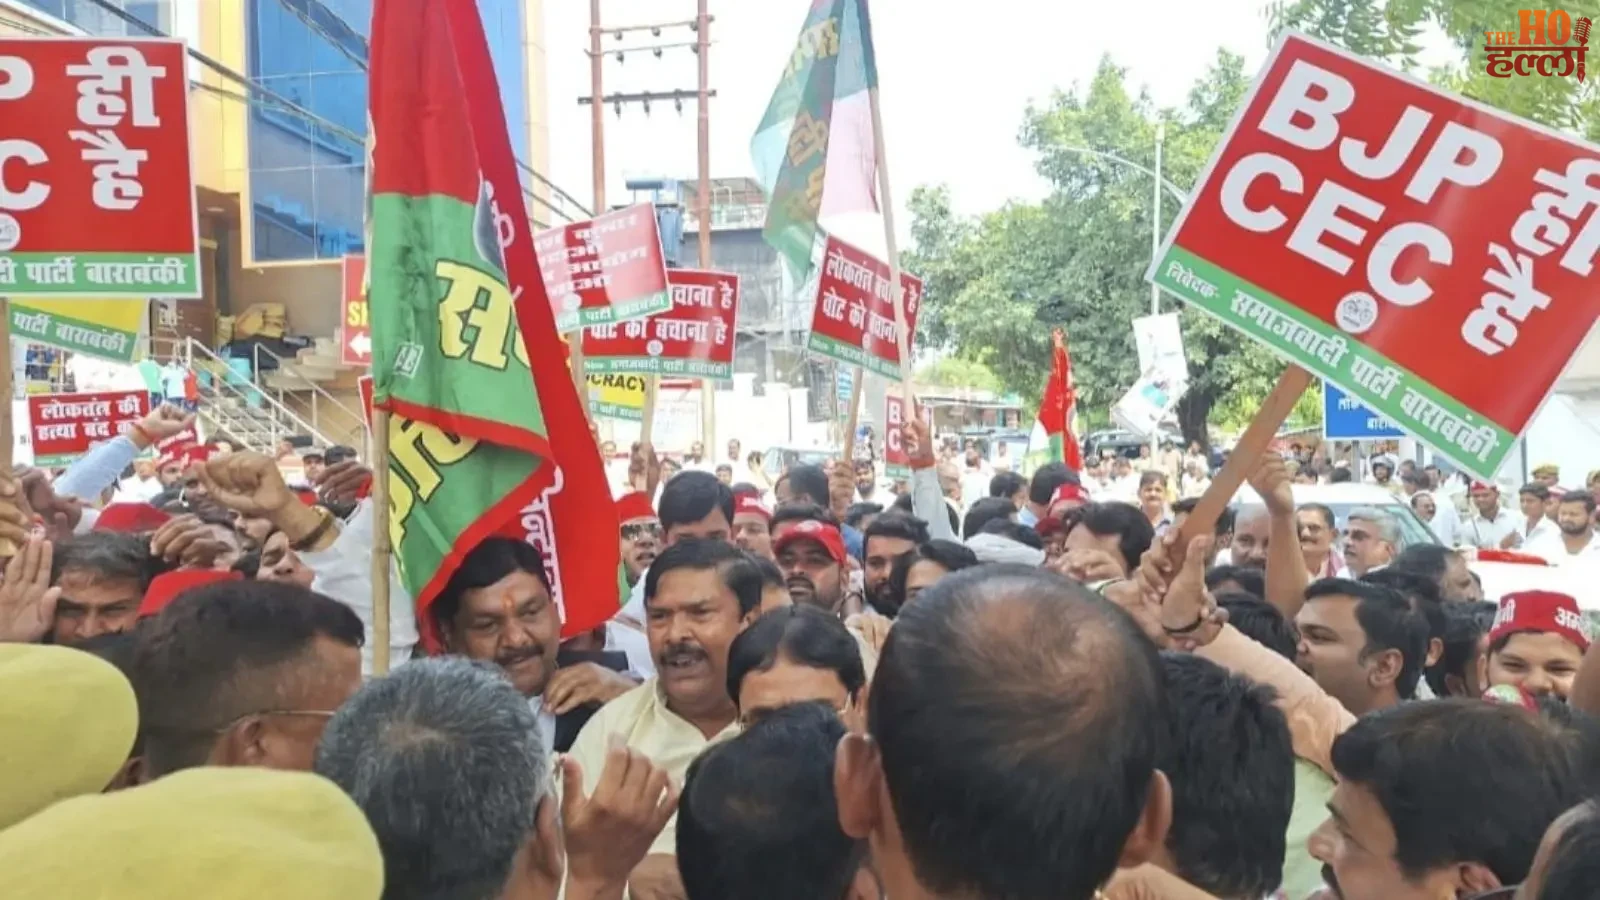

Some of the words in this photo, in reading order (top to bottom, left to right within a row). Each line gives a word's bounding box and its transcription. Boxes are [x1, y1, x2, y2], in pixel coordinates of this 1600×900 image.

[66, 46, 167, 127] ही
[68, 129, 148, 210] है
[1257, 58, 1504, 204] BJP
[1510, 157, 1600, 277] ही
[25, 256, 77, 285] पार्टी
[84, 256, 188, 286] बाराबंकी
[1219, 151, 1454, 306] CEC
[1461, 242, 1552, 356] है
[56, 322, 130, 353] बाराबंकी
[1230, 288, 1350, 368] समाजवादी
[1350, 354, 1404, 401] पार्टी
[1400, 385, 1500, 463] बाराबंकी
[115, 395, 141, 415] की
